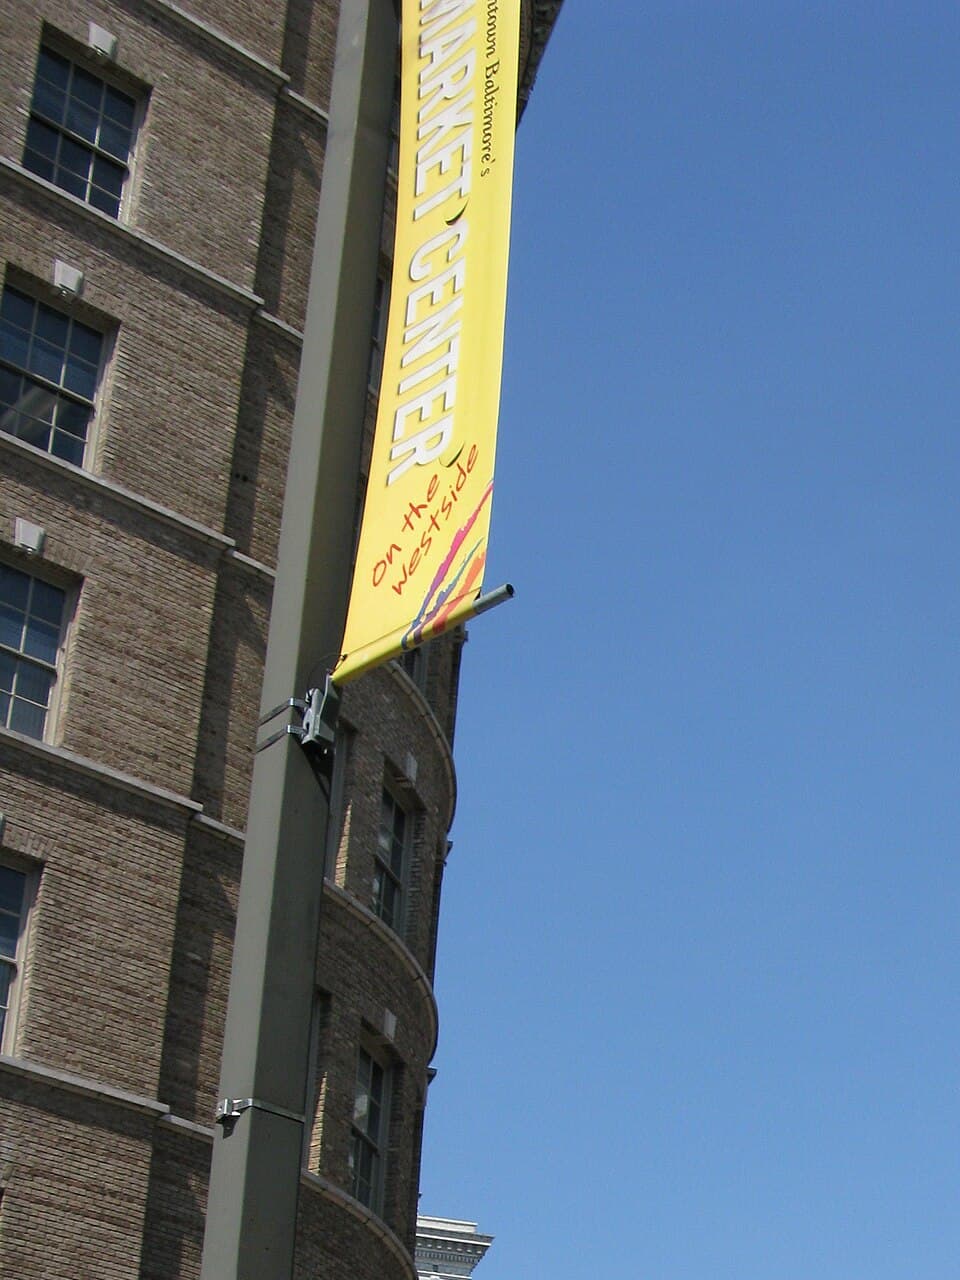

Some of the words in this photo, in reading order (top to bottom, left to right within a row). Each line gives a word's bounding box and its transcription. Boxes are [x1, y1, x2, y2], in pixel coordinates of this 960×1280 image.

[414, 0, 476, 221] MARKET
[480, 58, 500, 178] Baltimore's
[386, 223, 468, 486] CENTER
[371, 544, 402, 587] on
[401, 474, 440, 533] the
[391, 444, 478, 595] westside
